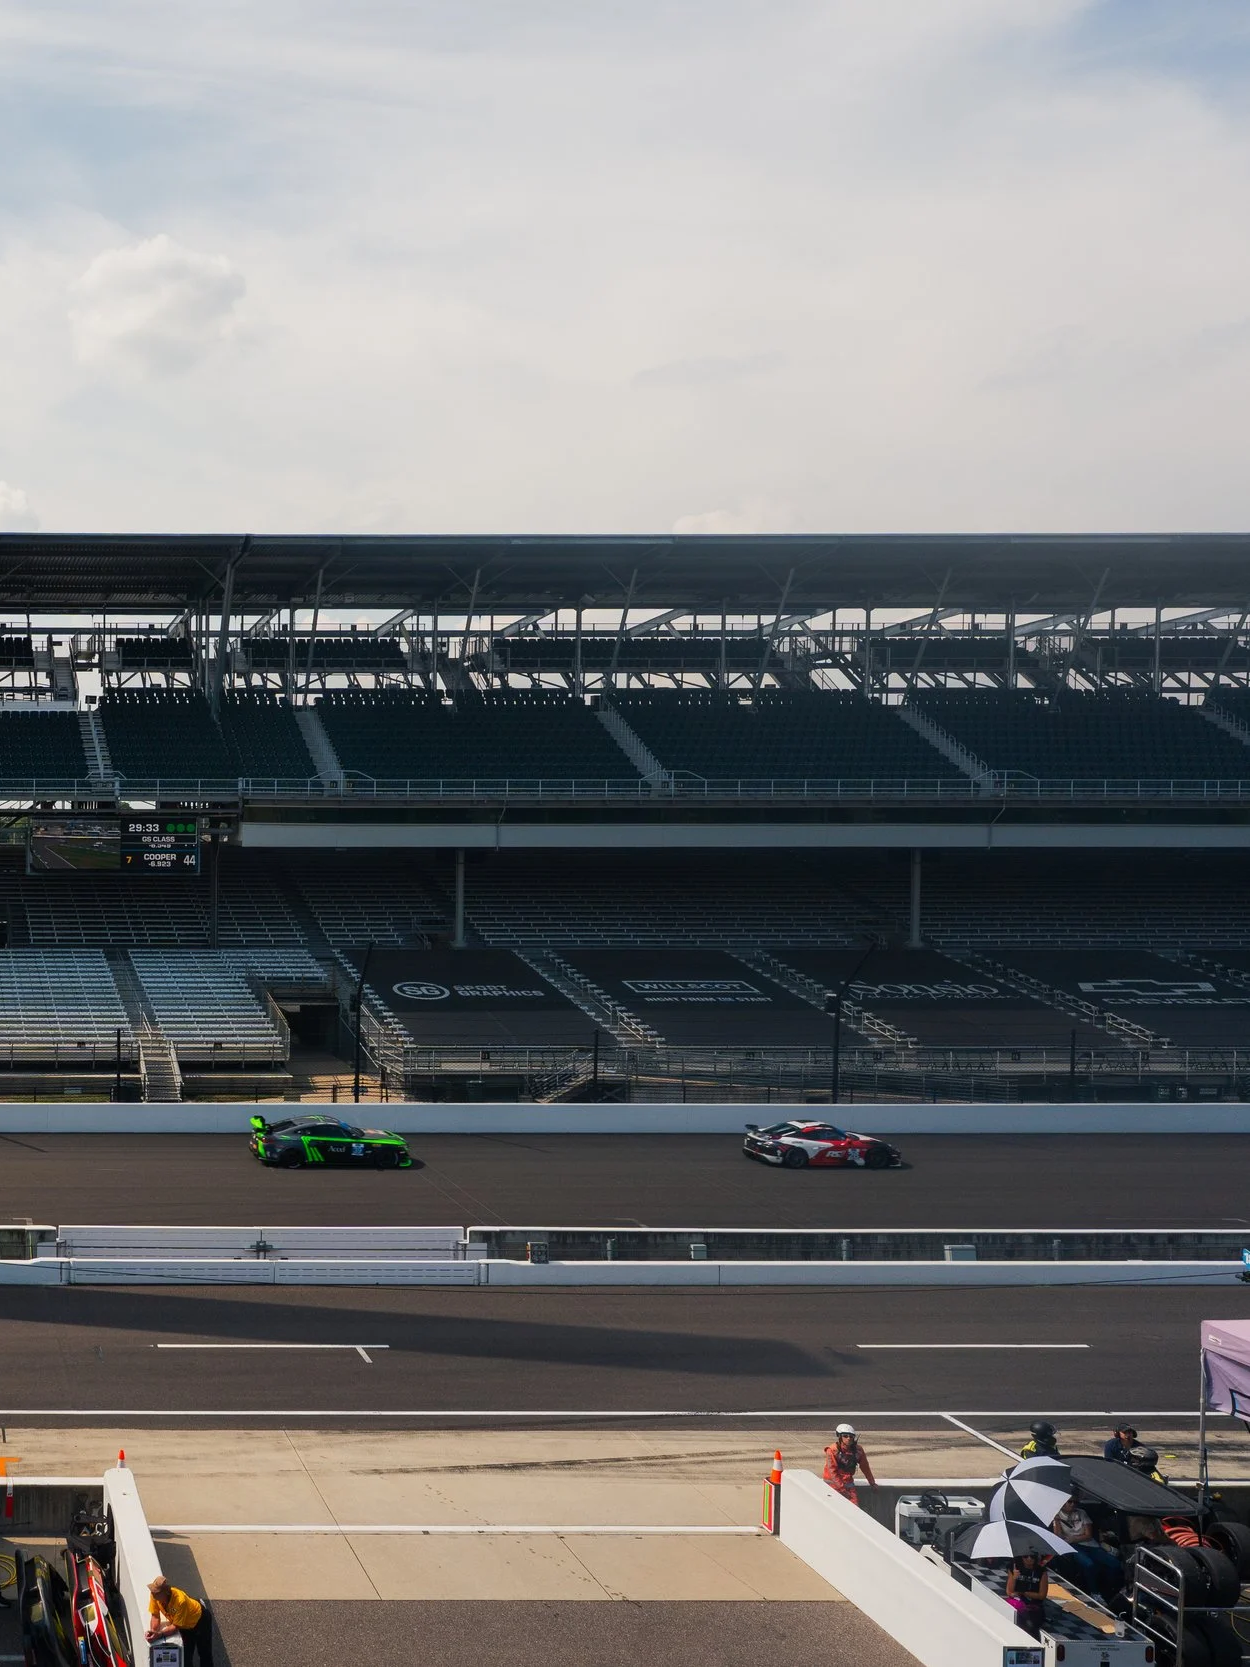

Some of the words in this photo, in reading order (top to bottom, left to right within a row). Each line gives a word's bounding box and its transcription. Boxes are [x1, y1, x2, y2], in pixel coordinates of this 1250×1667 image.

[129, 824, 159, 832] 29:33
[183, 855, 196, 865] 44
[402, 986, 441, 995] SG
